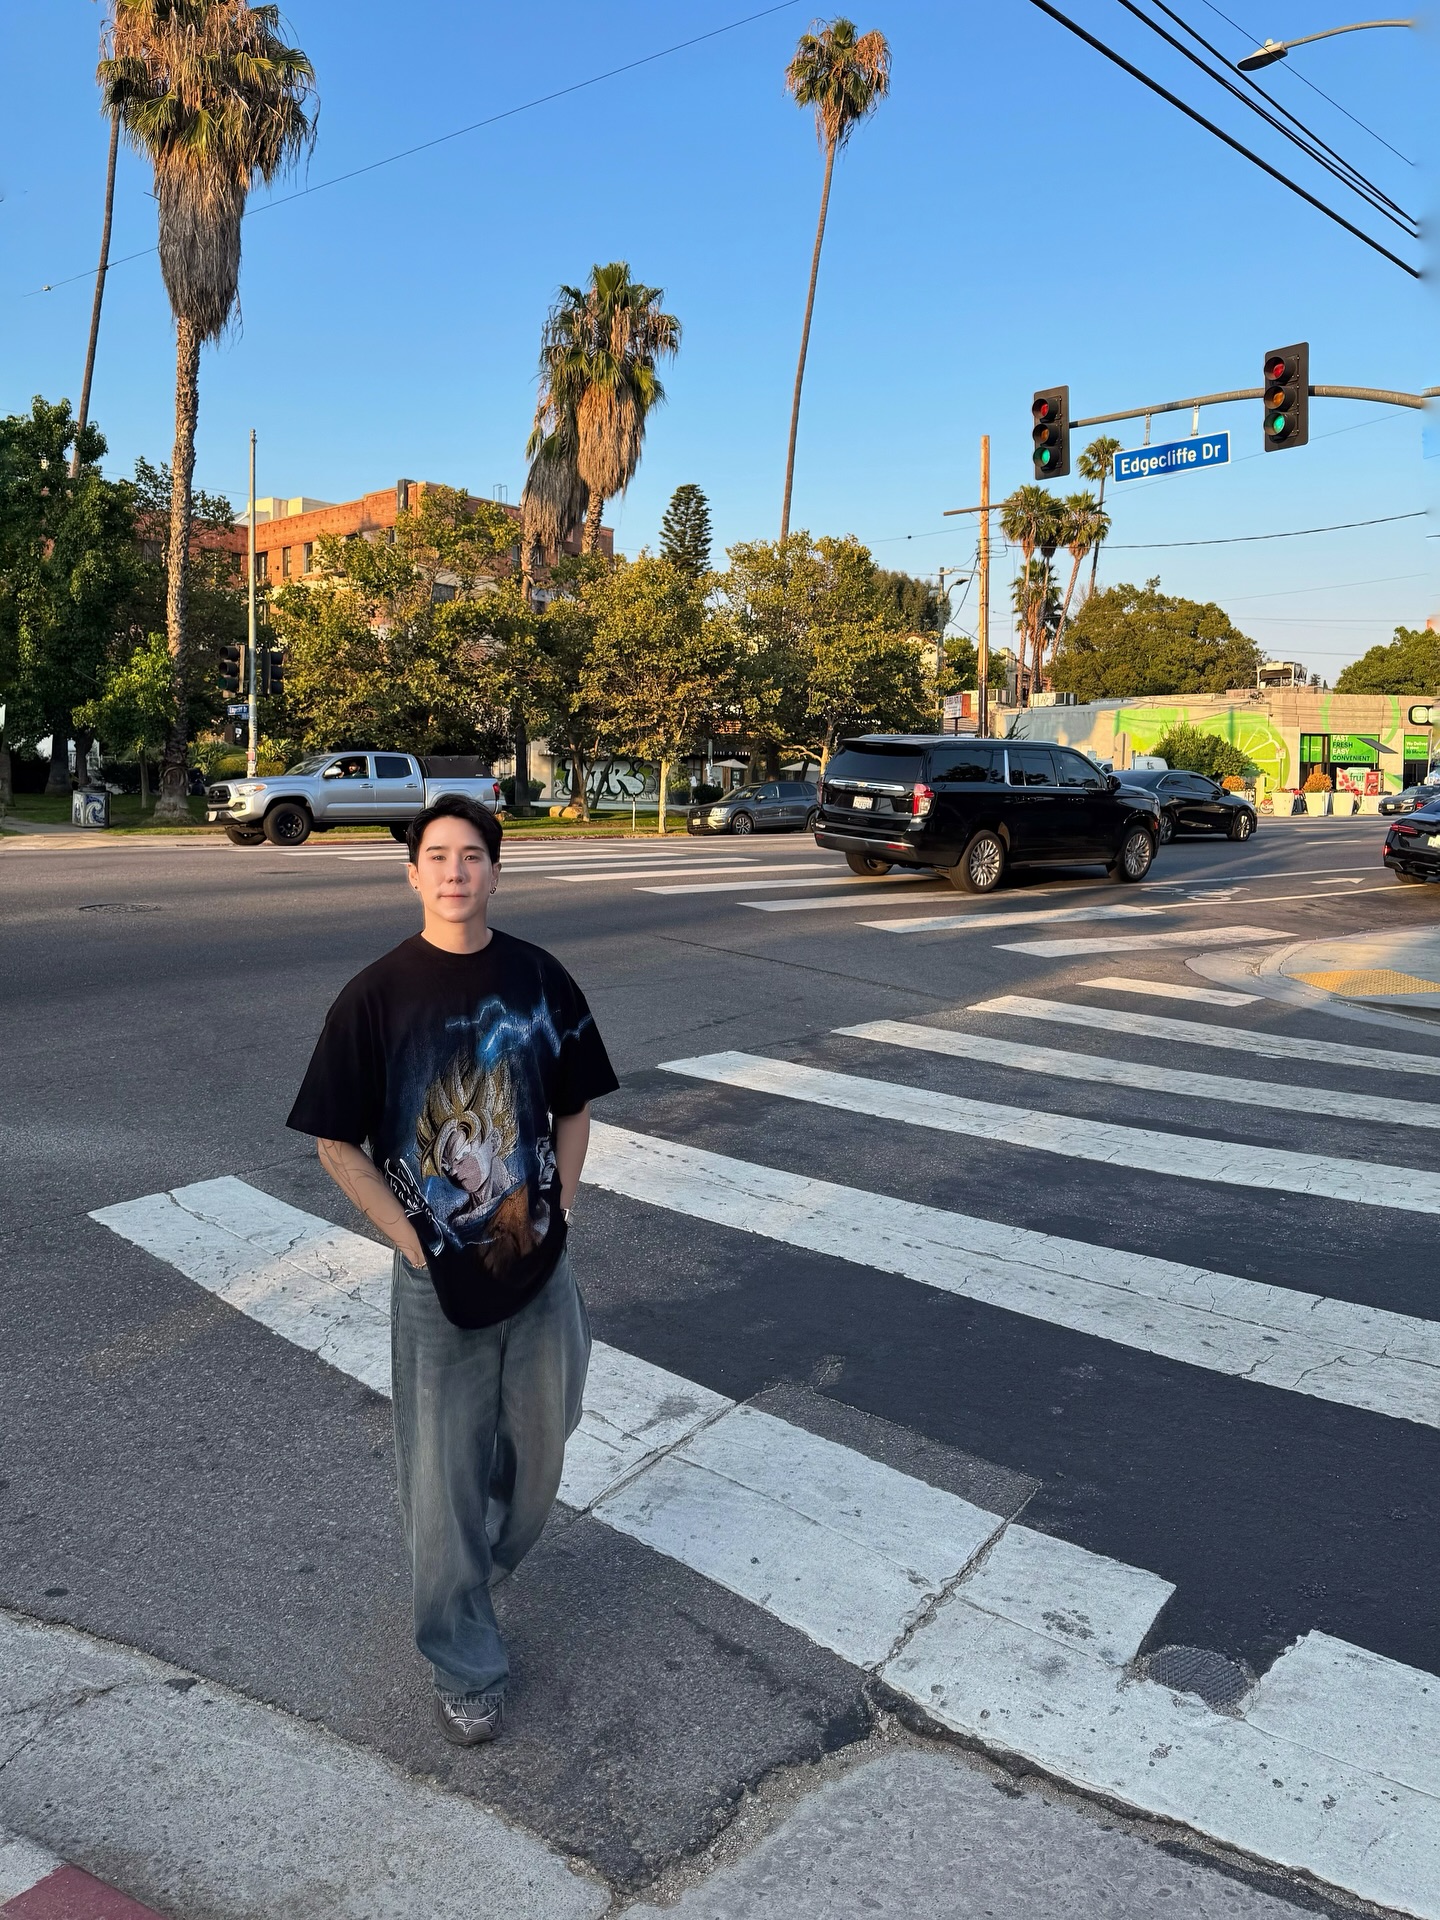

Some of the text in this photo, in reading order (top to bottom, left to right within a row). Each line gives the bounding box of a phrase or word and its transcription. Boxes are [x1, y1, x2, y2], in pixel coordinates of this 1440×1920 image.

[1121, 443, 1221, 475] Edgecliffe Dr
[1350, 772, 1365, 782] frui
